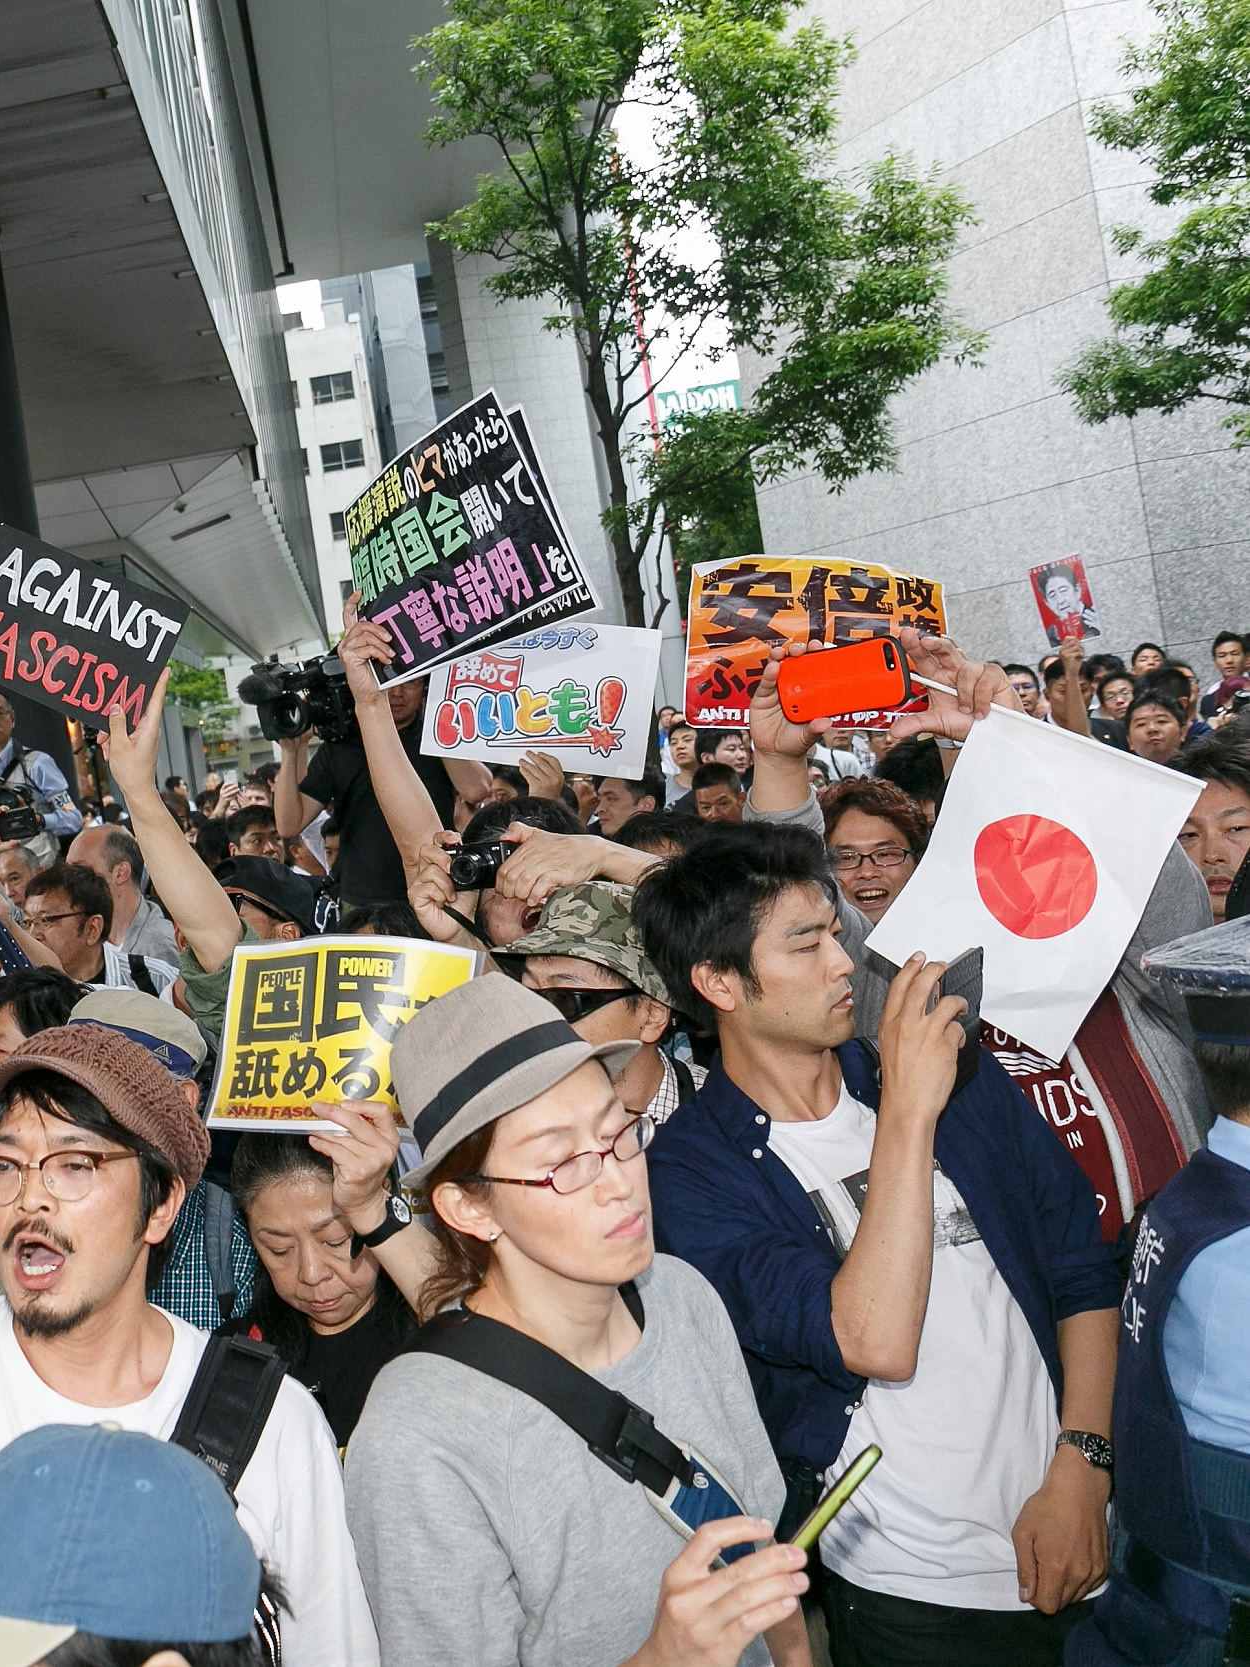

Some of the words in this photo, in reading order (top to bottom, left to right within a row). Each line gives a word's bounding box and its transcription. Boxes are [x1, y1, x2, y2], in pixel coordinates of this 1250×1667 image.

[346, 407, 510, 548] 応援演説のヒマがあったら
[351, 462, 535, 608] 臨時国会開いて
[359, 537, 574, 665] 丁寧な説明」を
[455, 657, 515, 688] 辞めて
[260, 968, 303, 988] PEOPLE
[338, 957, 395, 977] POWER
[237, 950, 437, 1046] 国民
[229, 1046, 399, 1102] 舐める
[227, 1103, 267, 1117] ANTI
[1066, 1130, 1084, 1149] IN
